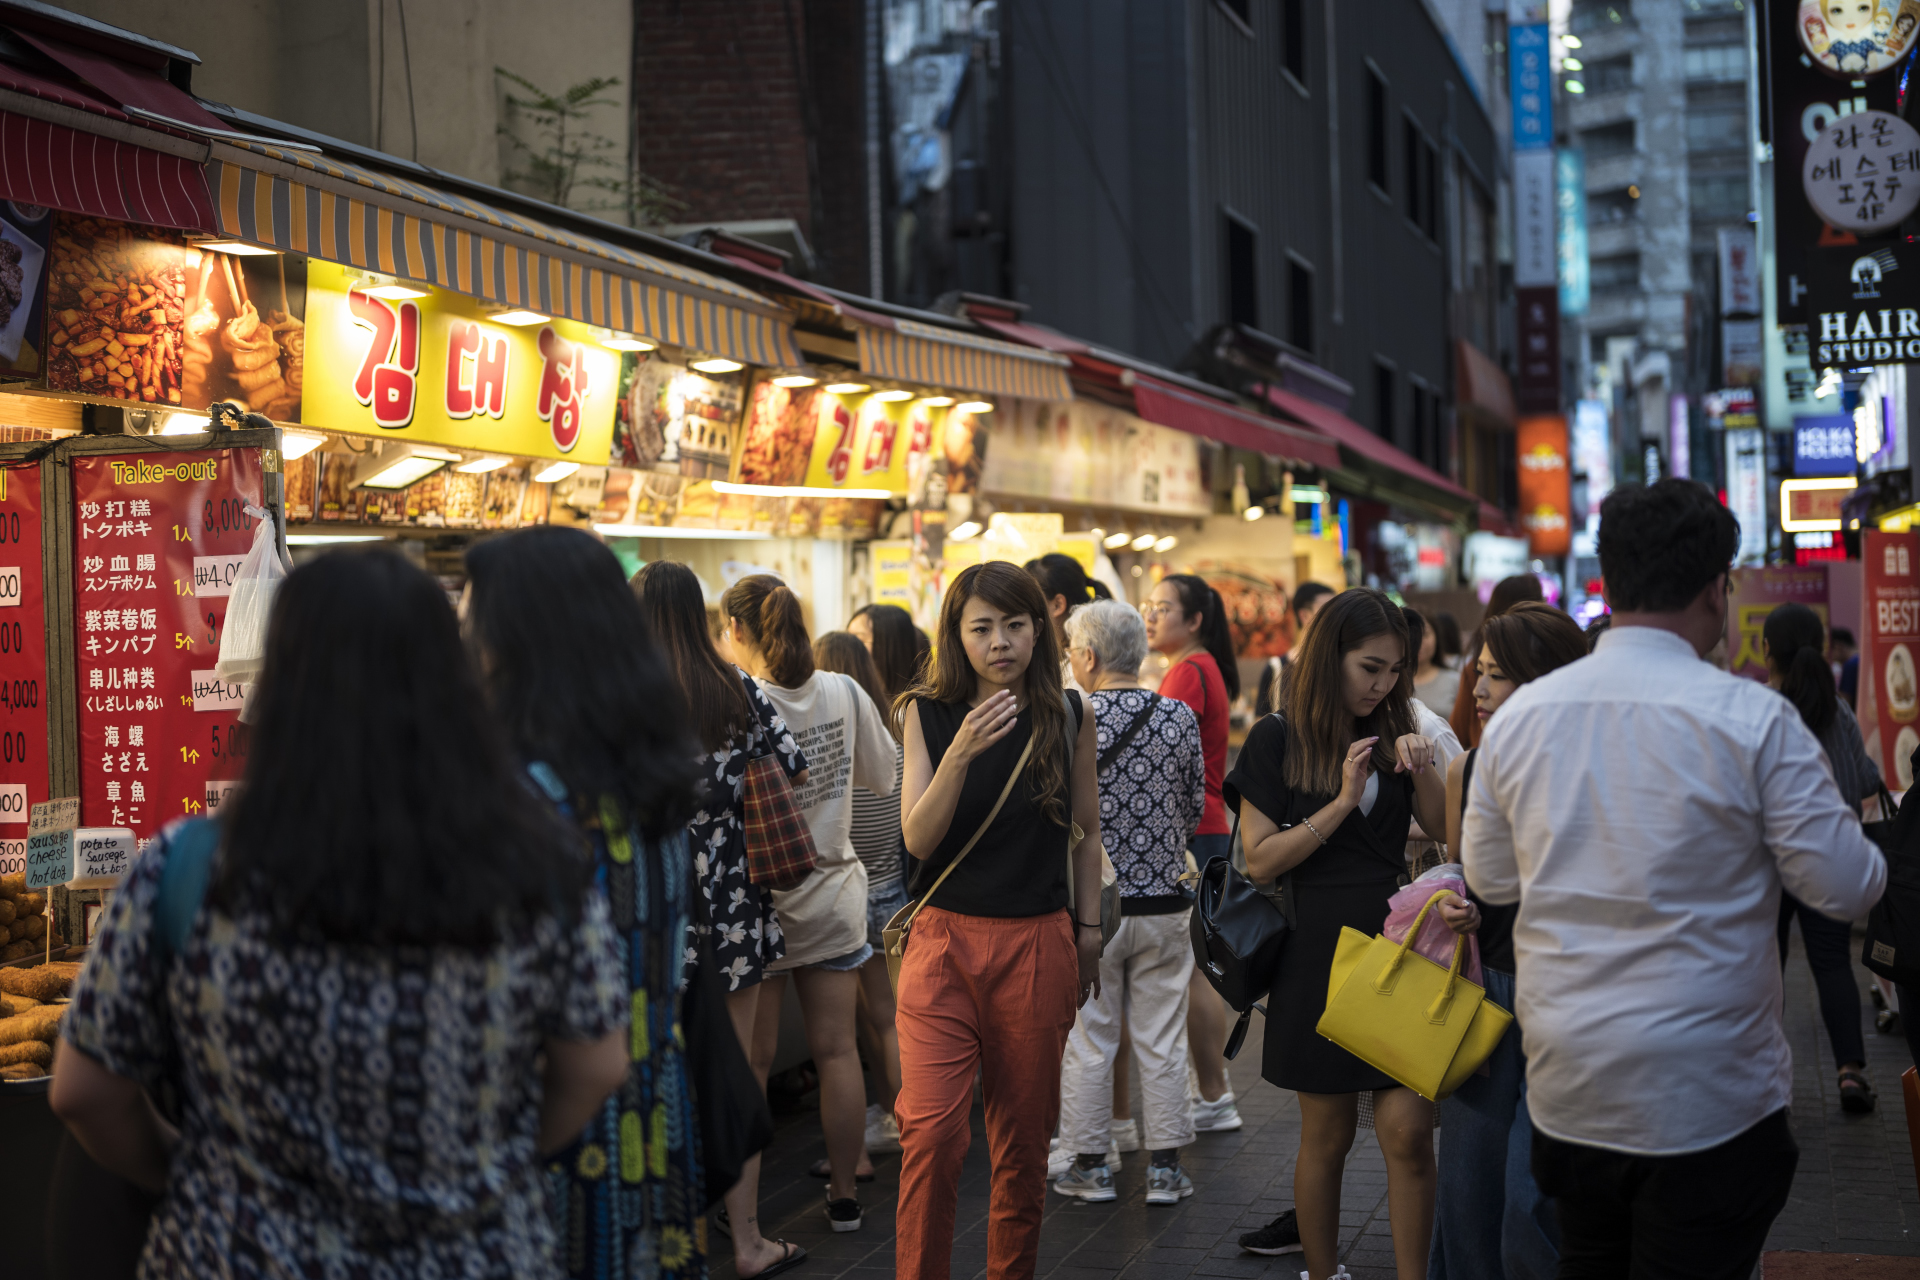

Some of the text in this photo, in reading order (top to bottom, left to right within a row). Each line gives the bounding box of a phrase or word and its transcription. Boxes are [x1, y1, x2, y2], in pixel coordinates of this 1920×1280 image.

[1856, 202, 1884, 221] 4F
[1819, 308, 1920, 342] HAIR
[1818, 338, 1920, 364] STUDIO
[111, 458, 217, 485] Take-out
[80, 499, 151, 520] 炒打糕
[82, 520, 152, 540] トクポキ
[172, 525, 192, 542] 1人
[83, 553, 156, 574] 炒血腸
[85, 574, 157, 592] スンデポクム
[173, 580, 194, 596] 1人
[86, 634, 157, 656] キンパプ
[89, 667, 155, 690] 串儿种类
[1, 680, 38, 714] 4,000
[86, 695, 163, 713] くしざししゅるい
[104, 725, 144, 747] 海螺
[101, 752, 149, 773] さざえ
[106, 780, 145, 803] 章魚
[111, 805, 142, 826] たこ
[80, 837, 118, 857] potato
